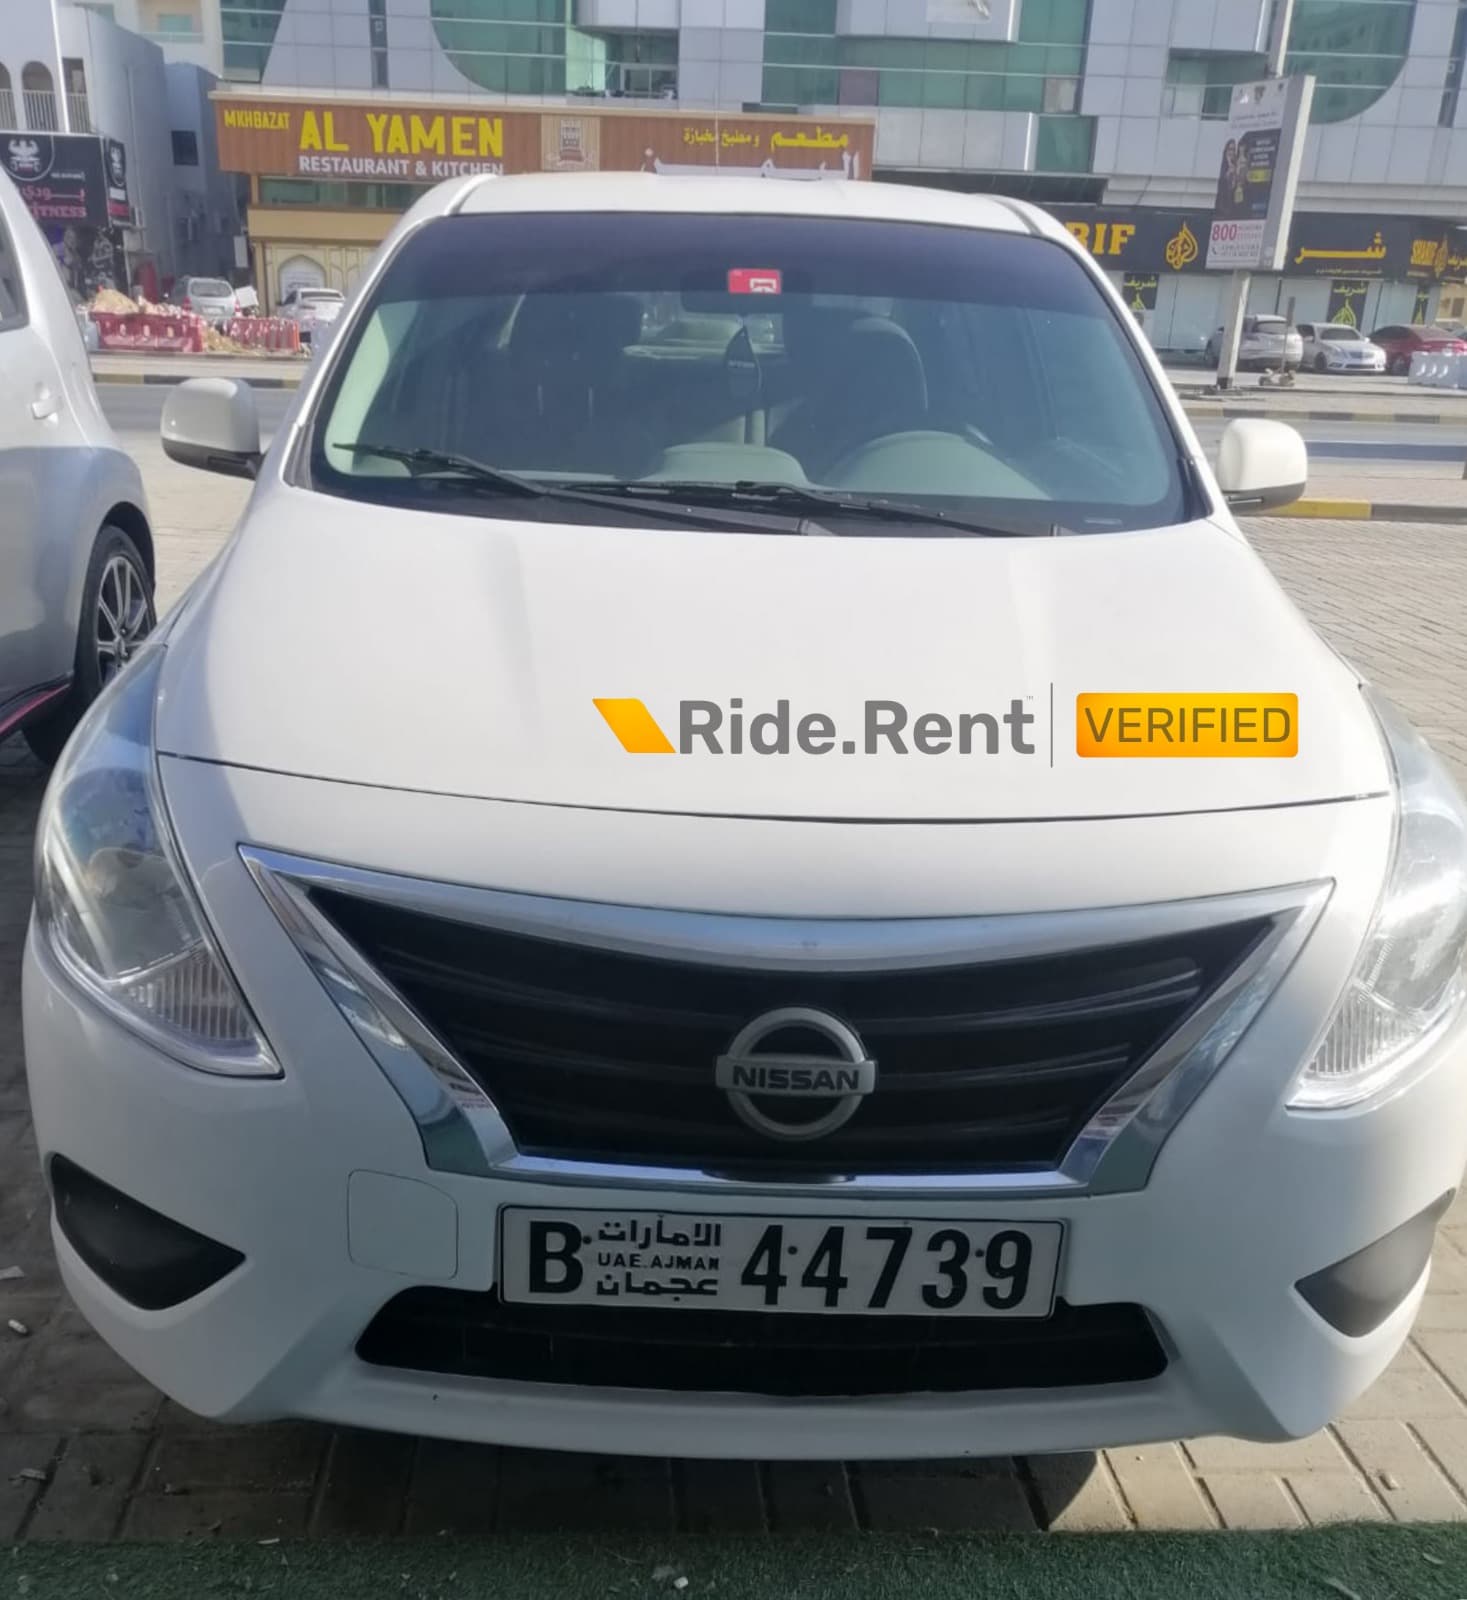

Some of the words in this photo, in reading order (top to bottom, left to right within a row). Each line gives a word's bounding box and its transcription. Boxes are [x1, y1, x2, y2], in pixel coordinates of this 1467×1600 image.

[224, 110, 290, 130] MKHBAZAT
[299, 110, 349, 151] AL
[365, 113, 503, 157] YAMEN
[770, 126, 849, 152] مطعم
[299, 155, 409, 175] RESTAURANT
[415, 160, 427, 176] &
[431, 161, 504, 177] KITCHEN
[1212, 223, 1237, 241] 800
[732, 1065, 860, 1091] NISSAN
[598, 1219, 721, 1249] الامارات
[529, 1221, 583, 1294] B
[741, 1224, 1033, 1310] 44739
[596, 1271, 719, 1302] عجمان
